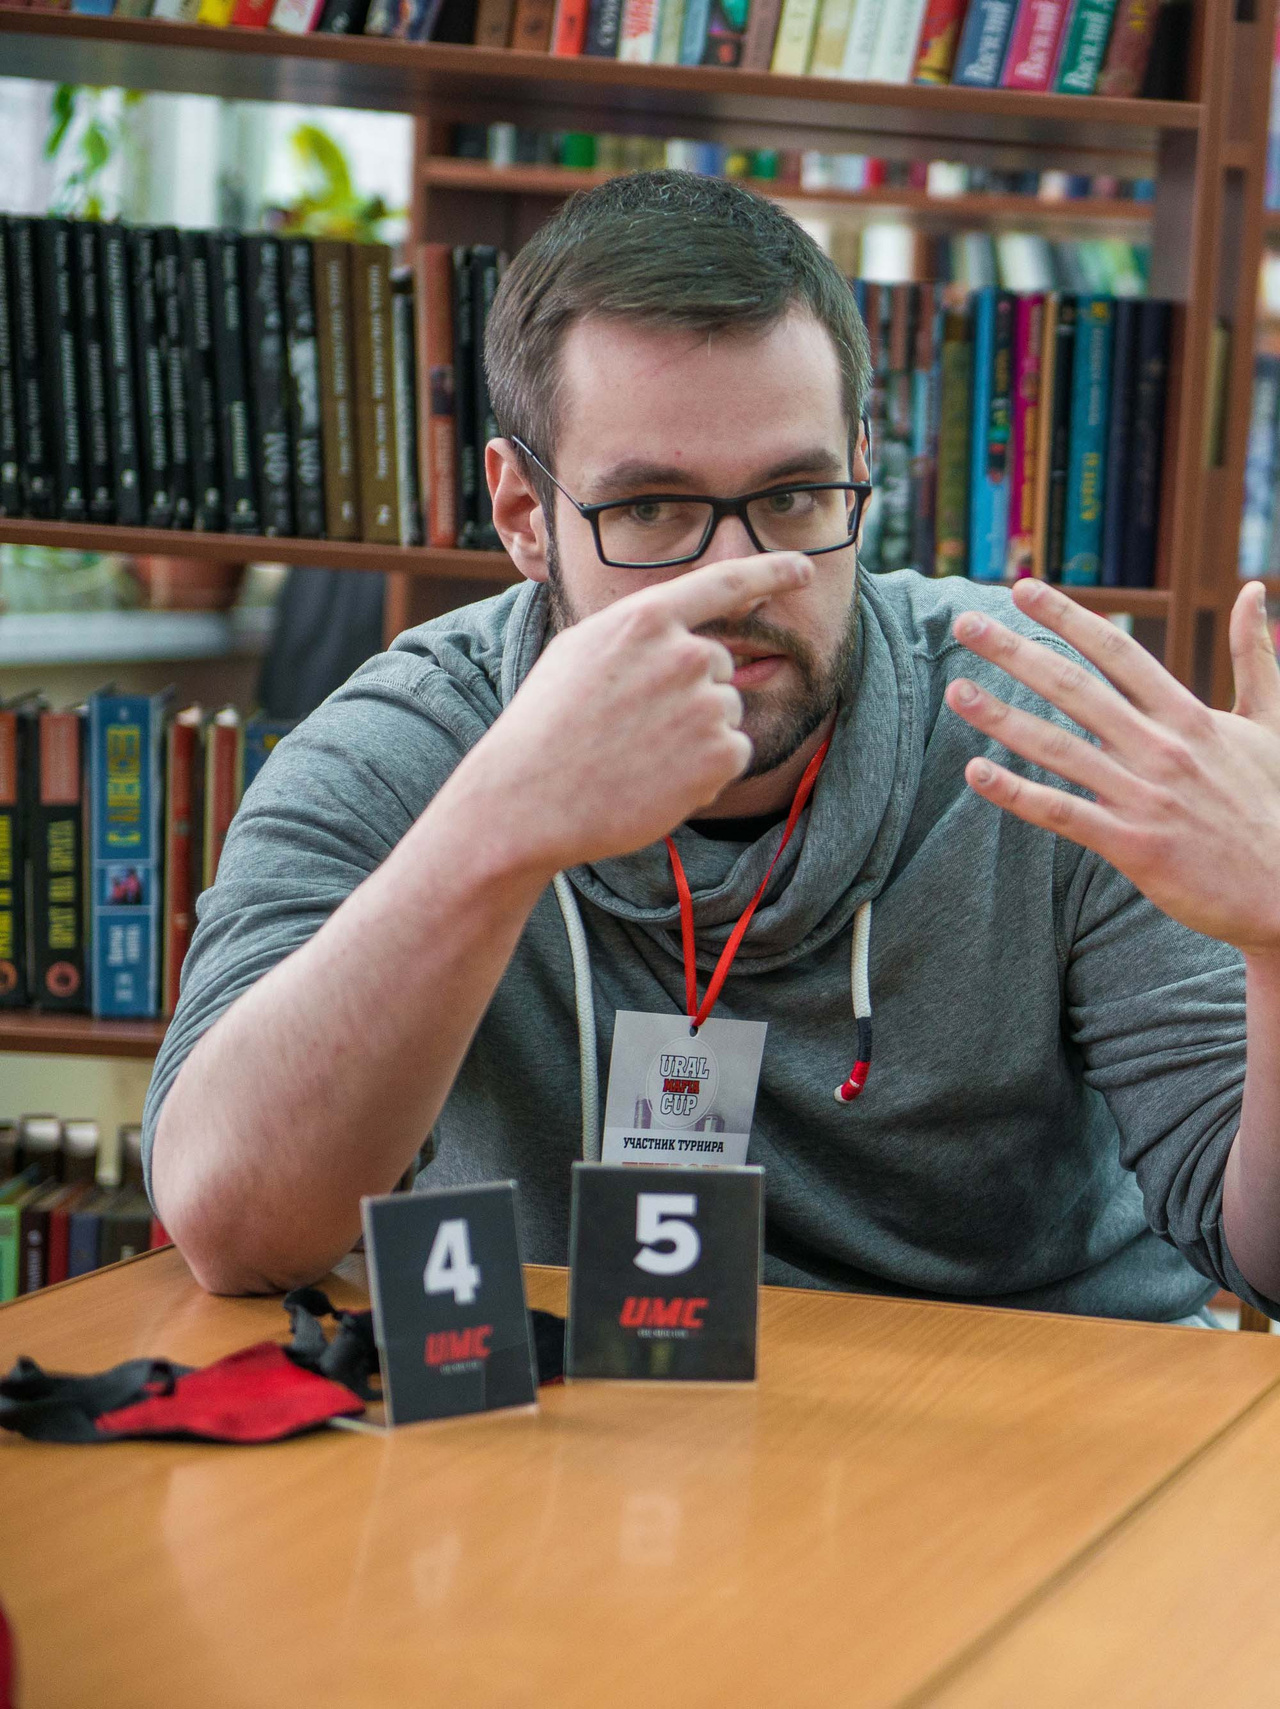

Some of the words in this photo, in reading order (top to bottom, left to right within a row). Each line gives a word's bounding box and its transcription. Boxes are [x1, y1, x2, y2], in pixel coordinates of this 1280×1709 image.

[660, 1054, 710, 1080] URAL
[663, 1079, 700, 1094] MAFIA
[660, 1093, 699, 1116] CUP
[623, 1137, 676, 1151] УЧАСТНИК
[677, 1139, 724, 1153] ТУРНИРА
[632, 1192, 701, 1276] 5
[422, 1217, 481, 1306] 4
[618, 1296, 709, 1329] UMC
[424, 1324, 494, 1366] UMC
